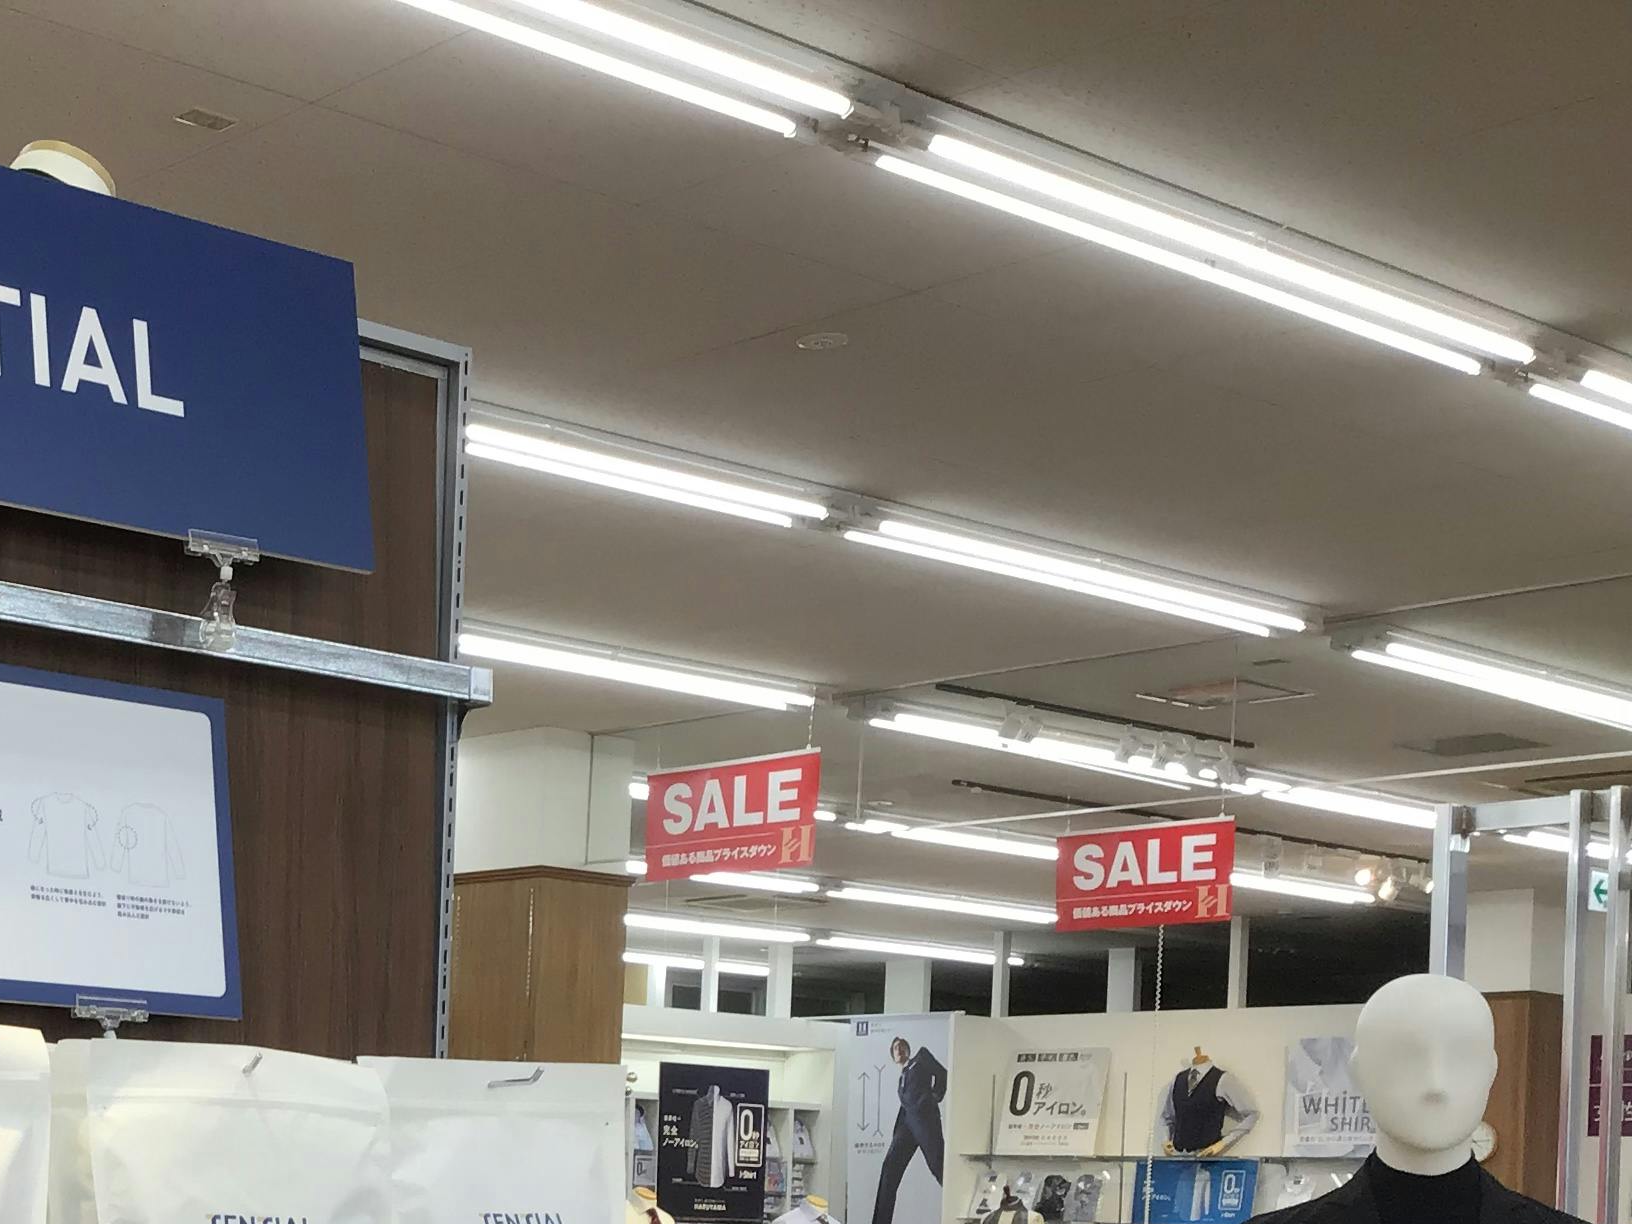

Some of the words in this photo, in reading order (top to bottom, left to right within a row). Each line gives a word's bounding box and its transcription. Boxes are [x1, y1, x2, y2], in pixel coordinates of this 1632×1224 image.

[663, 768, 802, 835] SALE
[1072, 833, 1217, 891] SALE
[1033, 1101, 1086, 1117] アイロン。
[1330, 1116, 1371, 1131] SHIR
